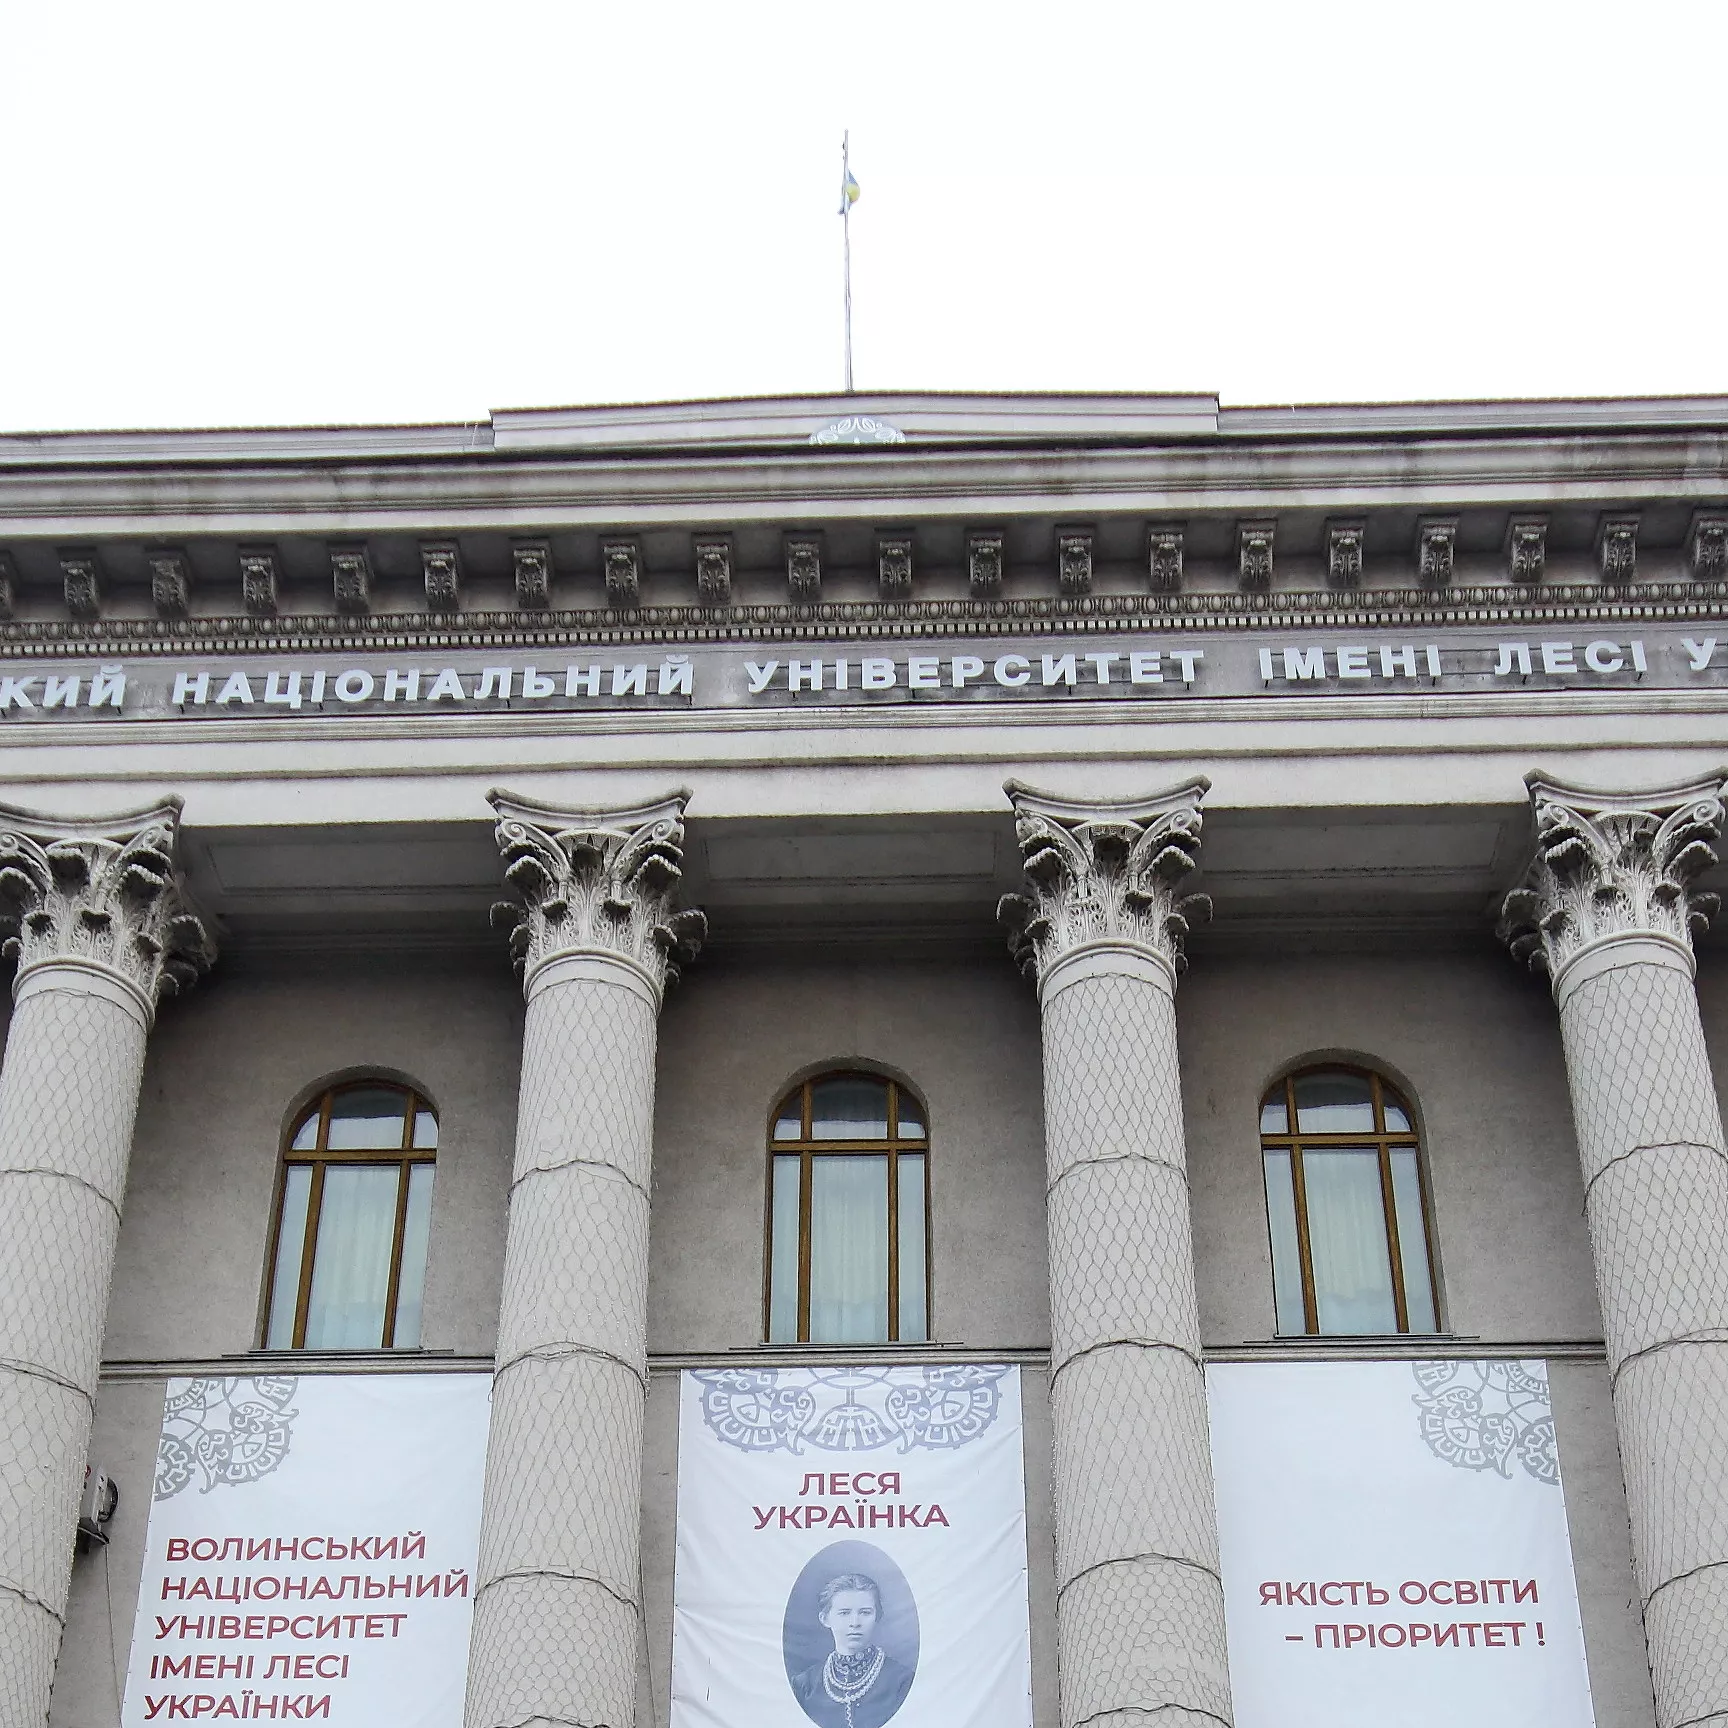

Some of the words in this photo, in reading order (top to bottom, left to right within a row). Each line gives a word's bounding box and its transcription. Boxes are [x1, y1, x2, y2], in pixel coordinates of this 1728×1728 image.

[172, 654, 695, 710] НАЦІОНАЛЬНИЙ
[743, 650, 1205, 694] УНІВЕРСИТЕТ
[1258, 644, 1442, 680] ІМЕНІ
[1494, 640, 1648, 676] ЛЕСІ
[798, 1472, 901, 1497] ЛЕСЯ
[752, 1498, 950, 1530] УКРАЇНКА
[166, 1530, 427, 1562] ВОЛИНСЬКИЙ
[161, 1568, 470, 1605] НАЦІОНАЛЬНИЙ
[1258, 1581, 1390, 1606] ЯКІСТЬ
[1398, 1580, 1539, 1605] ОСВІТИ
[154, 1613, 408, 1640] УНІВЕРСИТЕТ
[1314, 1622, 1527, 1648] ПРІОРИТЕТ
[150, 1654, 255, 1680] ІМЕНІ
[263, 1654, 350, 1680] ЛЕСІ
[144, 1689, 332, 1720] УКРАЇНКИ
